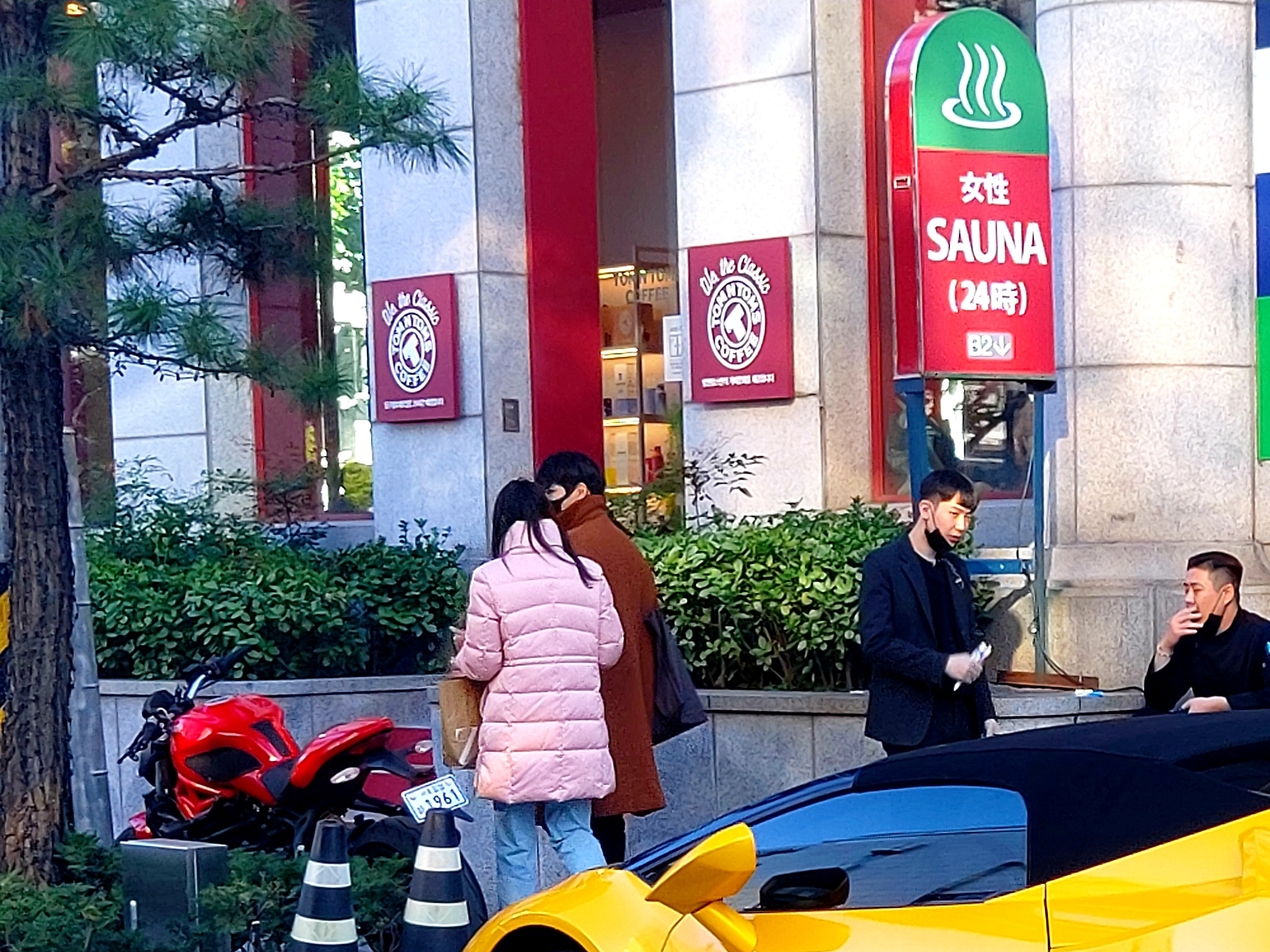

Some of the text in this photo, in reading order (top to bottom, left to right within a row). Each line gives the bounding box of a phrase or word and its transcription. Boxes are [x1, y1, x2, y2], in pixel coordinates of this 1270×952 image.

[959, 171, 1011, 205] 女性
[926, 217, 1048, 265] SAUNA
[948, 279, 1028, 316] (24時)
